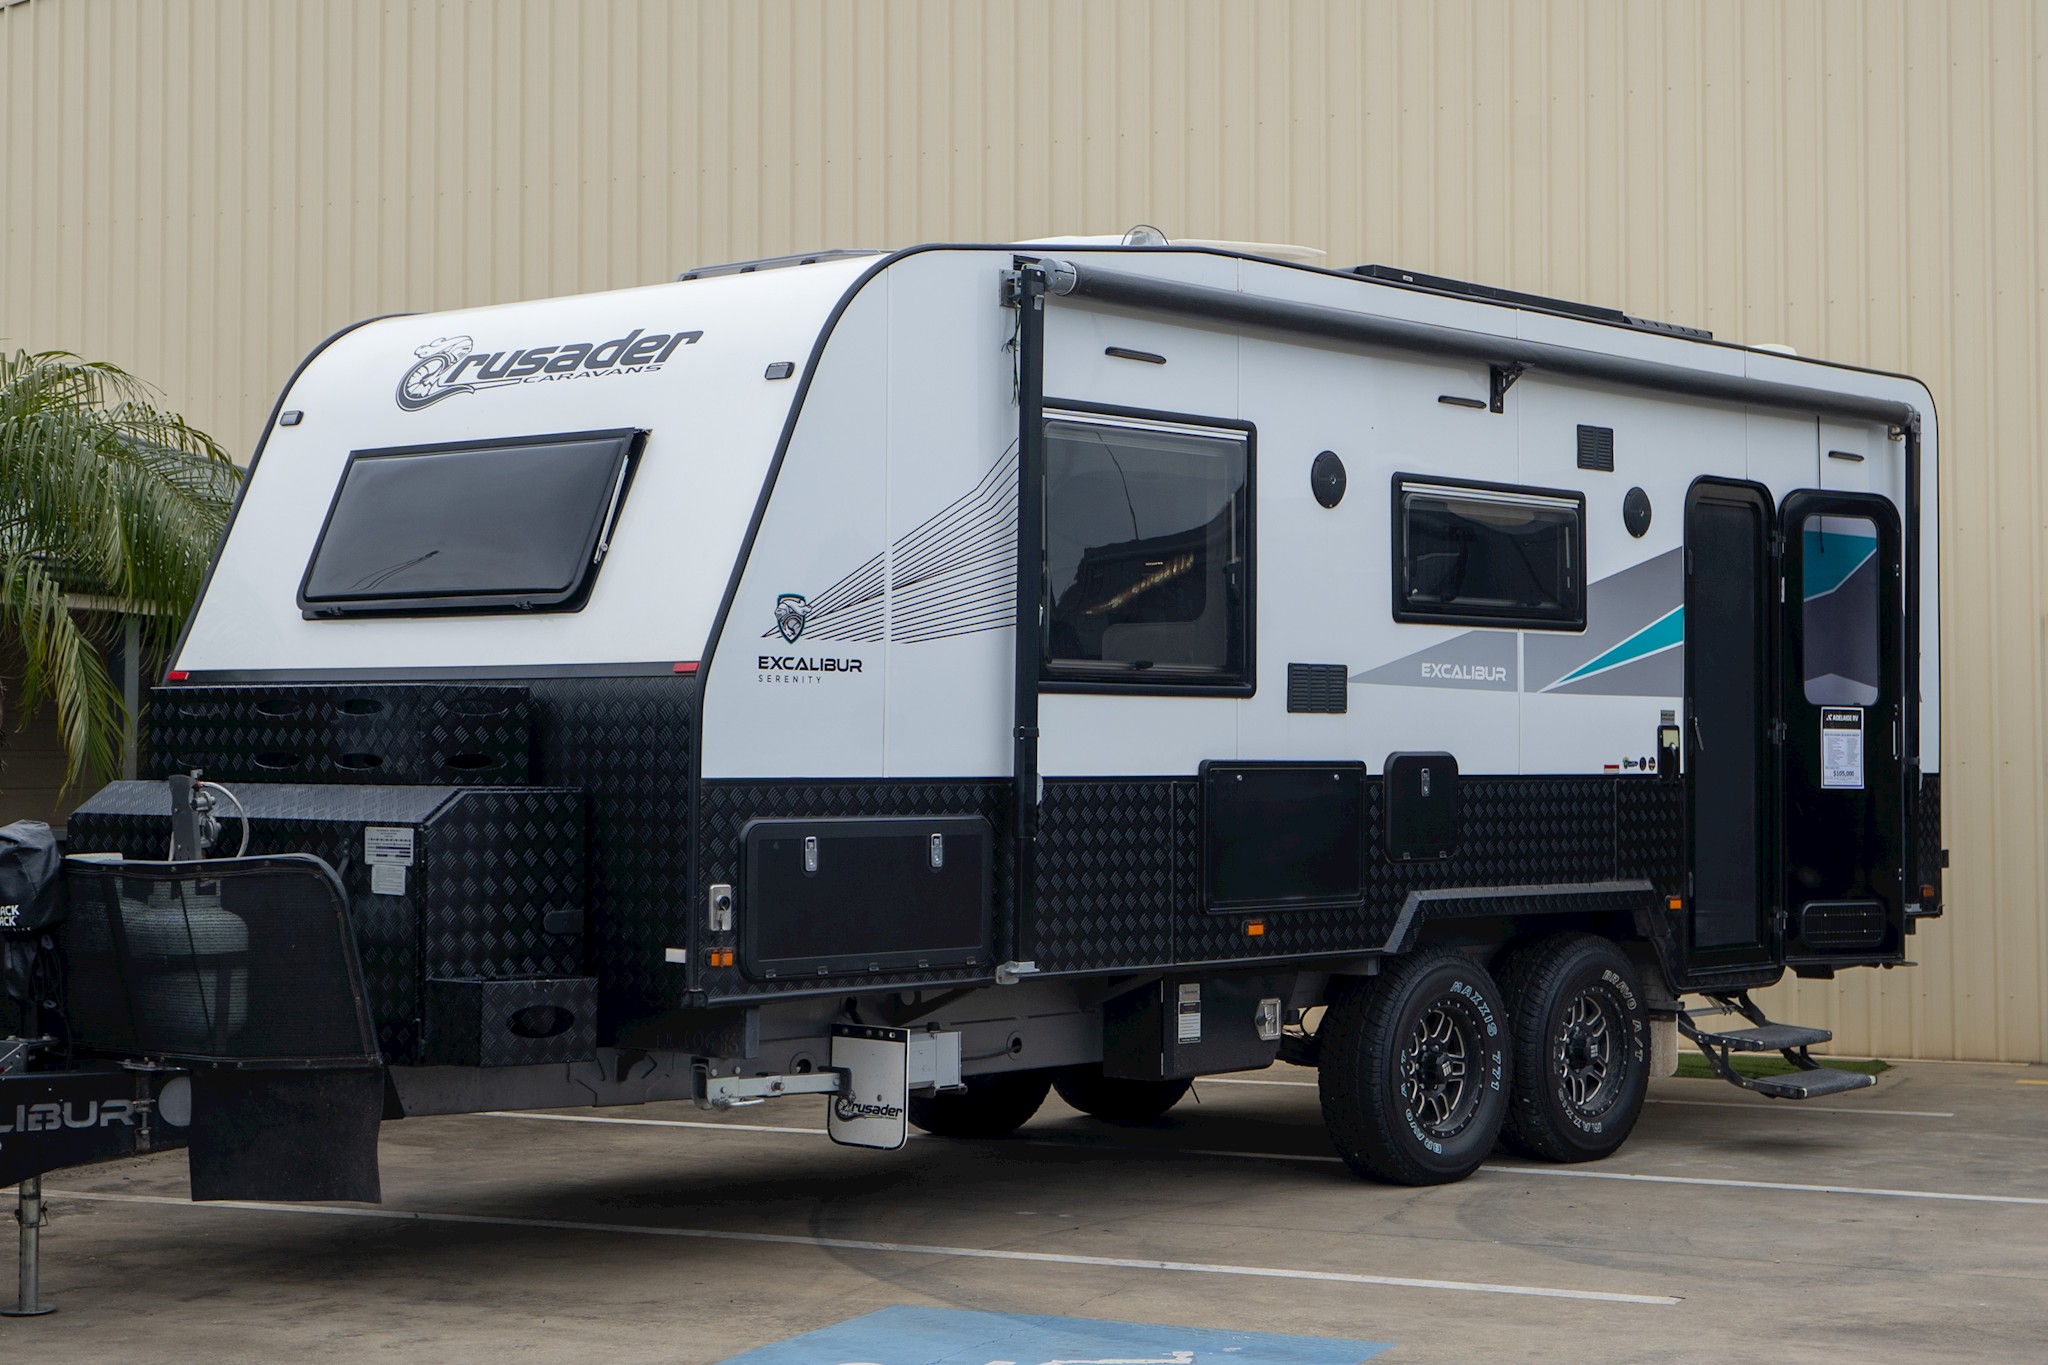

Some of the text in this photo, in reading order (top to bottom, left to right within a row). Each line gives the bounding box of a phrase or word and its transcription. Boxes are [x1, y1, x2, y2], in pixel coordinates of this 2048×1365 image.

[522, 364, 662, 384] CARAVANS
[758, 655, 863, 673] EXCALIBUR
[1421, 662, 1507, 682] EXCALIBUR
[758, 674, 822, 684] SERENITY
[1601, 969, 1644, 1063] BRAVO A/T
[1450, 981, 1502, 1091] MAXXIS 771
[1405, 1108, 1442, 1154] BRAVO
